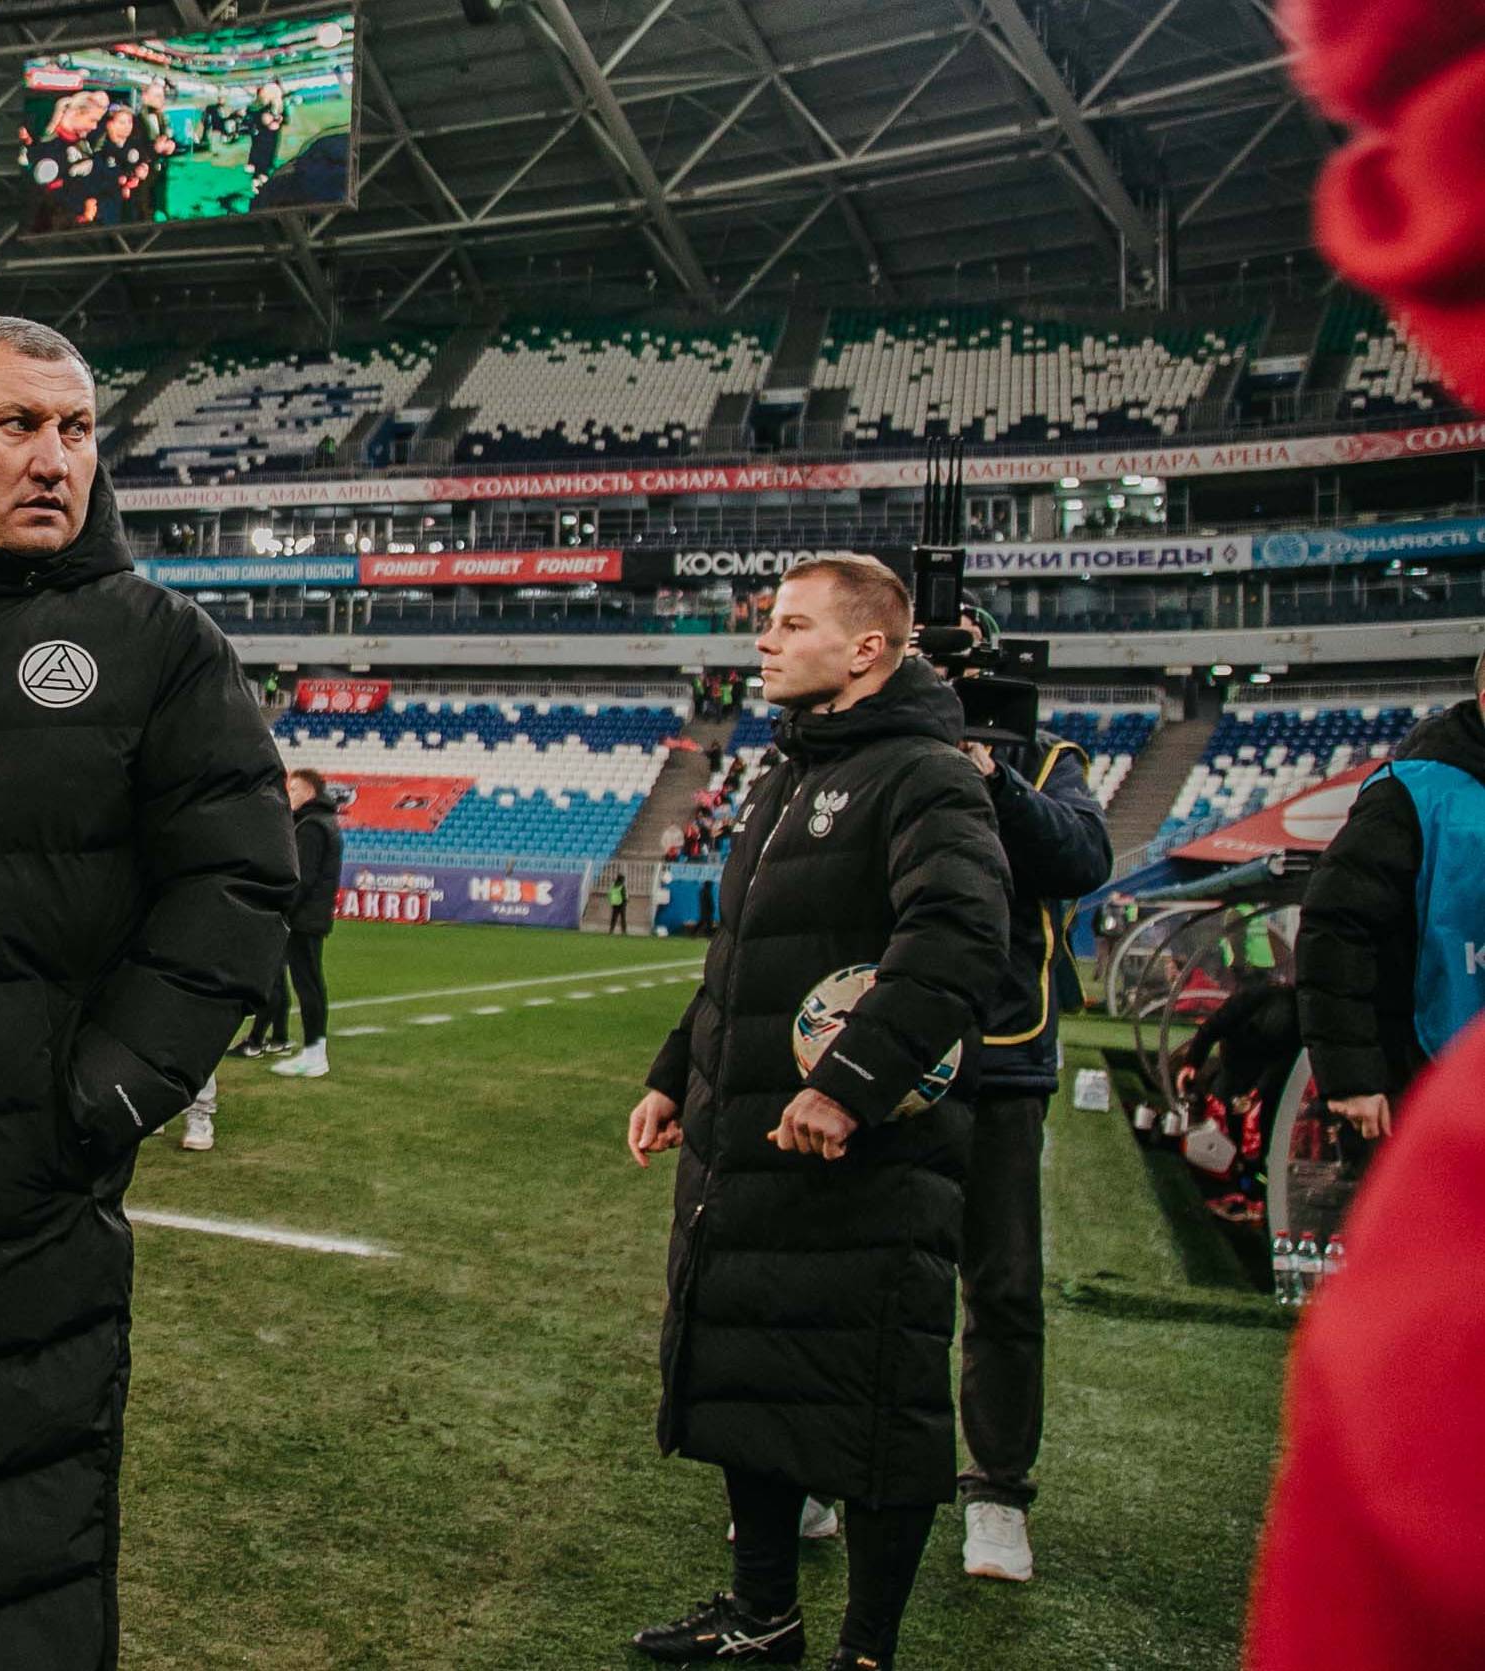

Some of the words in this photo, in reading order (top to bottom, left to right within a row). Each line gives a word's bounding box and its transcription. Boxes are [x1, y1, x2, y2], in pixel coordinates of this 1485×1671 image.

[1099, 452, 1200, 473] САМАРА
[1212, 446, 1290, 466] АРЕНА
[257, 486, 329, 502] САМАРА
[337, 483, 395, 499] АРЕНА
[473, 475, 633, 496] СОЛИДАРНОСТЬ
[641, 469, 728, 490] САМАРА
[737, 468, 803, 487] АРЕНА
[373, 560, 440, 577] FONBET
[452, 558, 523, 576] FONBET
[536, 556, 609, 574] FONBET
[1070, 546, 1213, 569] ПОБЕДЫ
[157, 565, 239, 583] ПРАВИТЕЛЬСТВО
[241, 563, 303, 581] САМАРСКОЙ
[305, 562, 354, 579] ОБЛАСТИ
